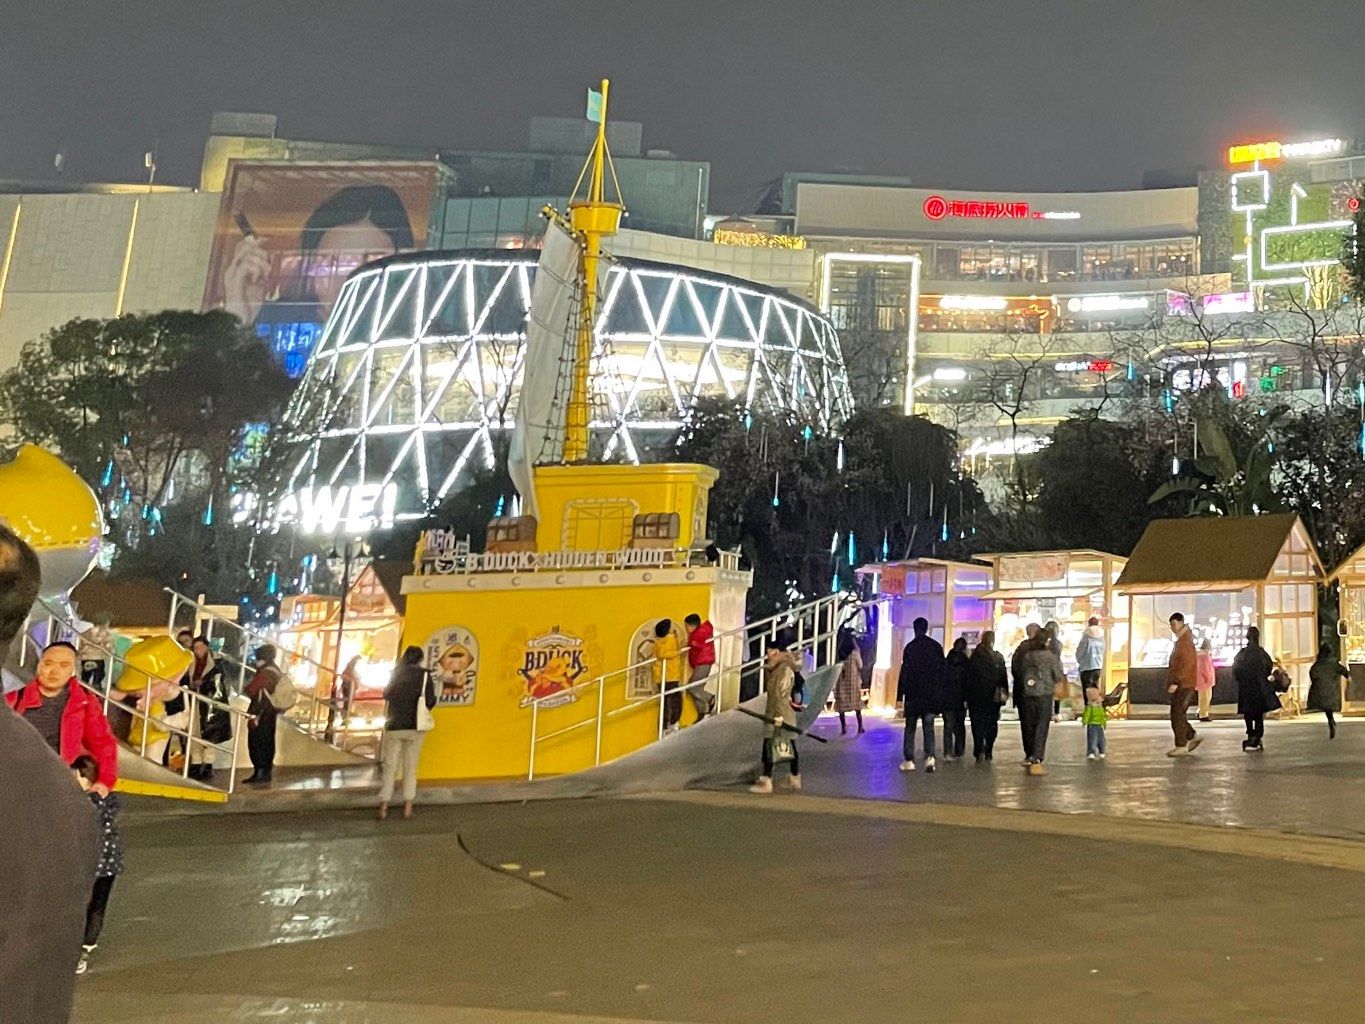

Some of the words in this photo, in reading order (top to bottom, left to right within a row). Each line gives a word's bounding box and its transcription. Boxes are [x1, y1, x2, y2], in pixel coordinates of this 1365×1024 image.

[466, 552, 530, 571] B.DUCK
[546, 550, 607, 568] HIDDEN
[615, 547, 664, 566] WOOD
